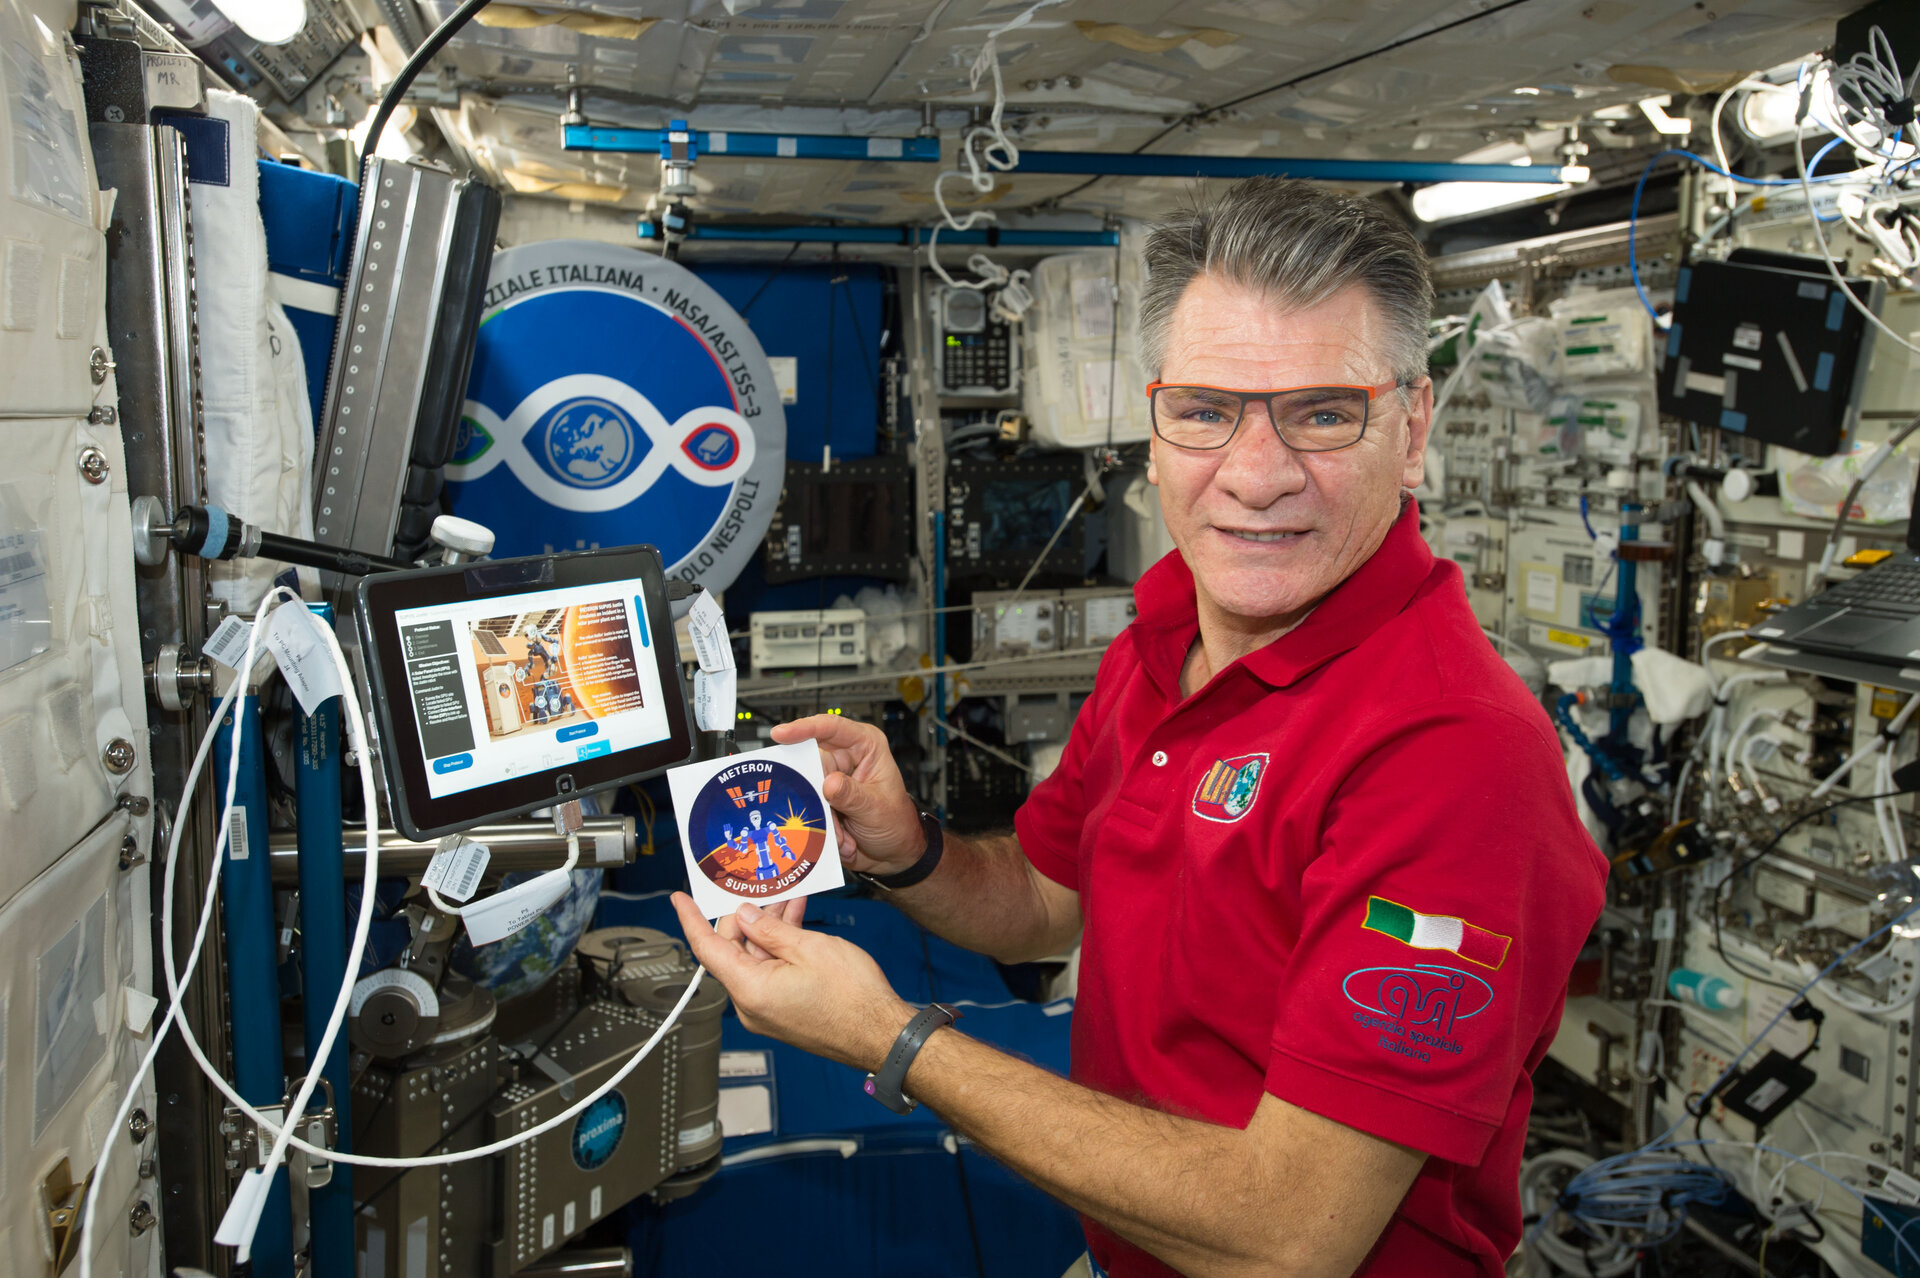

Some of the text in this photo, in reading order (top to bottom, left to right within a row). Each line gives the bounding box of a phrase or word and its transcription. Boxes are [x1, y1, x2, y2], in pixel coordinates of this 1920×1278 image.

[157, 72, 180, 85] MR
[547, 264, 645, 292] ITALIANA
[662, 288, 740, 364] NASA/ASI
[729, 362, 761, 419] ISS-3
[710, 477, 760, 554] NESPOLI
[717, 763, 773, 784] METERON
[725, 878, 768, 893] SUPVIS
[775, 859, 811, 890] JUSTIN
[1353, 1012, 1463, 1055] agenzia spaziale
[579, 1113, 623, 1149] proxima
